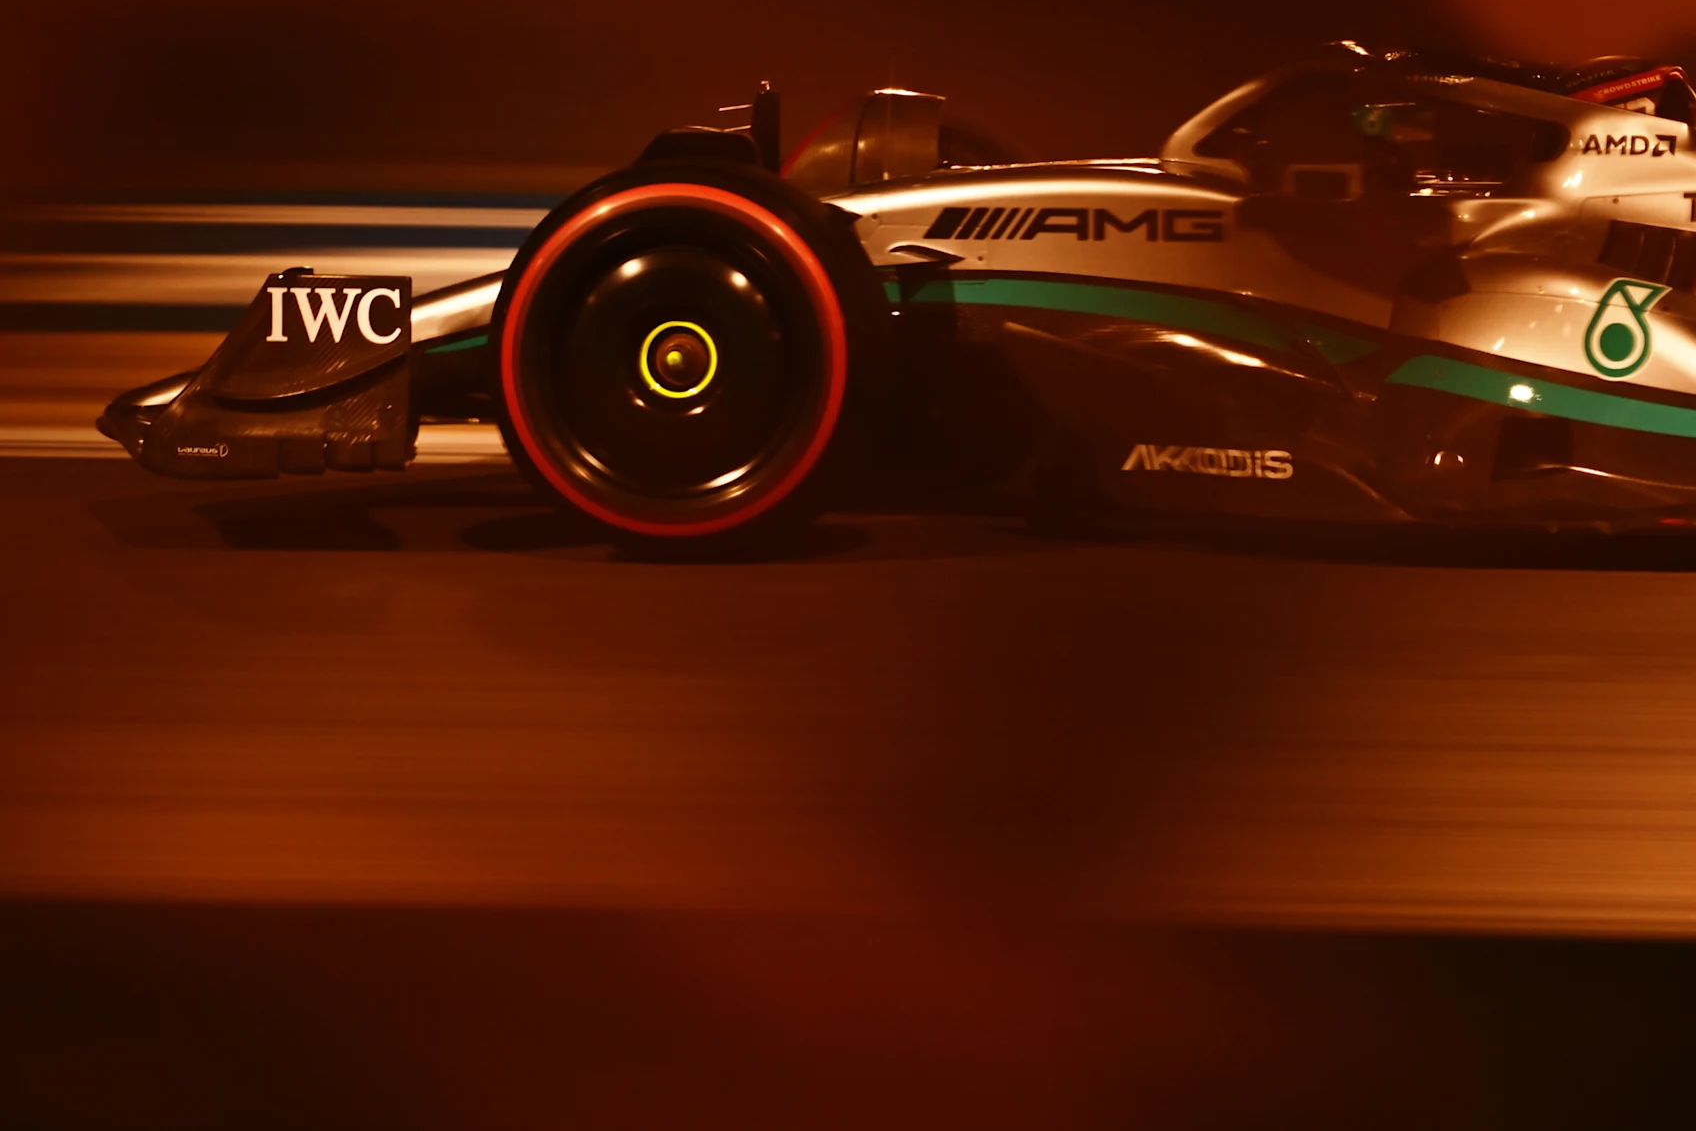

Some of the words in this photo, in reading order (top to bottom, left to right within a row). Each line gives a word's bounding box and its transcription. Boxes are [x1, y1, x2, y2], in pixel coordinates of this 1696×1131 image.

[1597, 74, 1662, 96] CROWDSTRIKE
[1582, 134, 1650, 156] AMD
[1026, 207, 1225, 242] AMG
[266, 287, 402, 344] IWC
